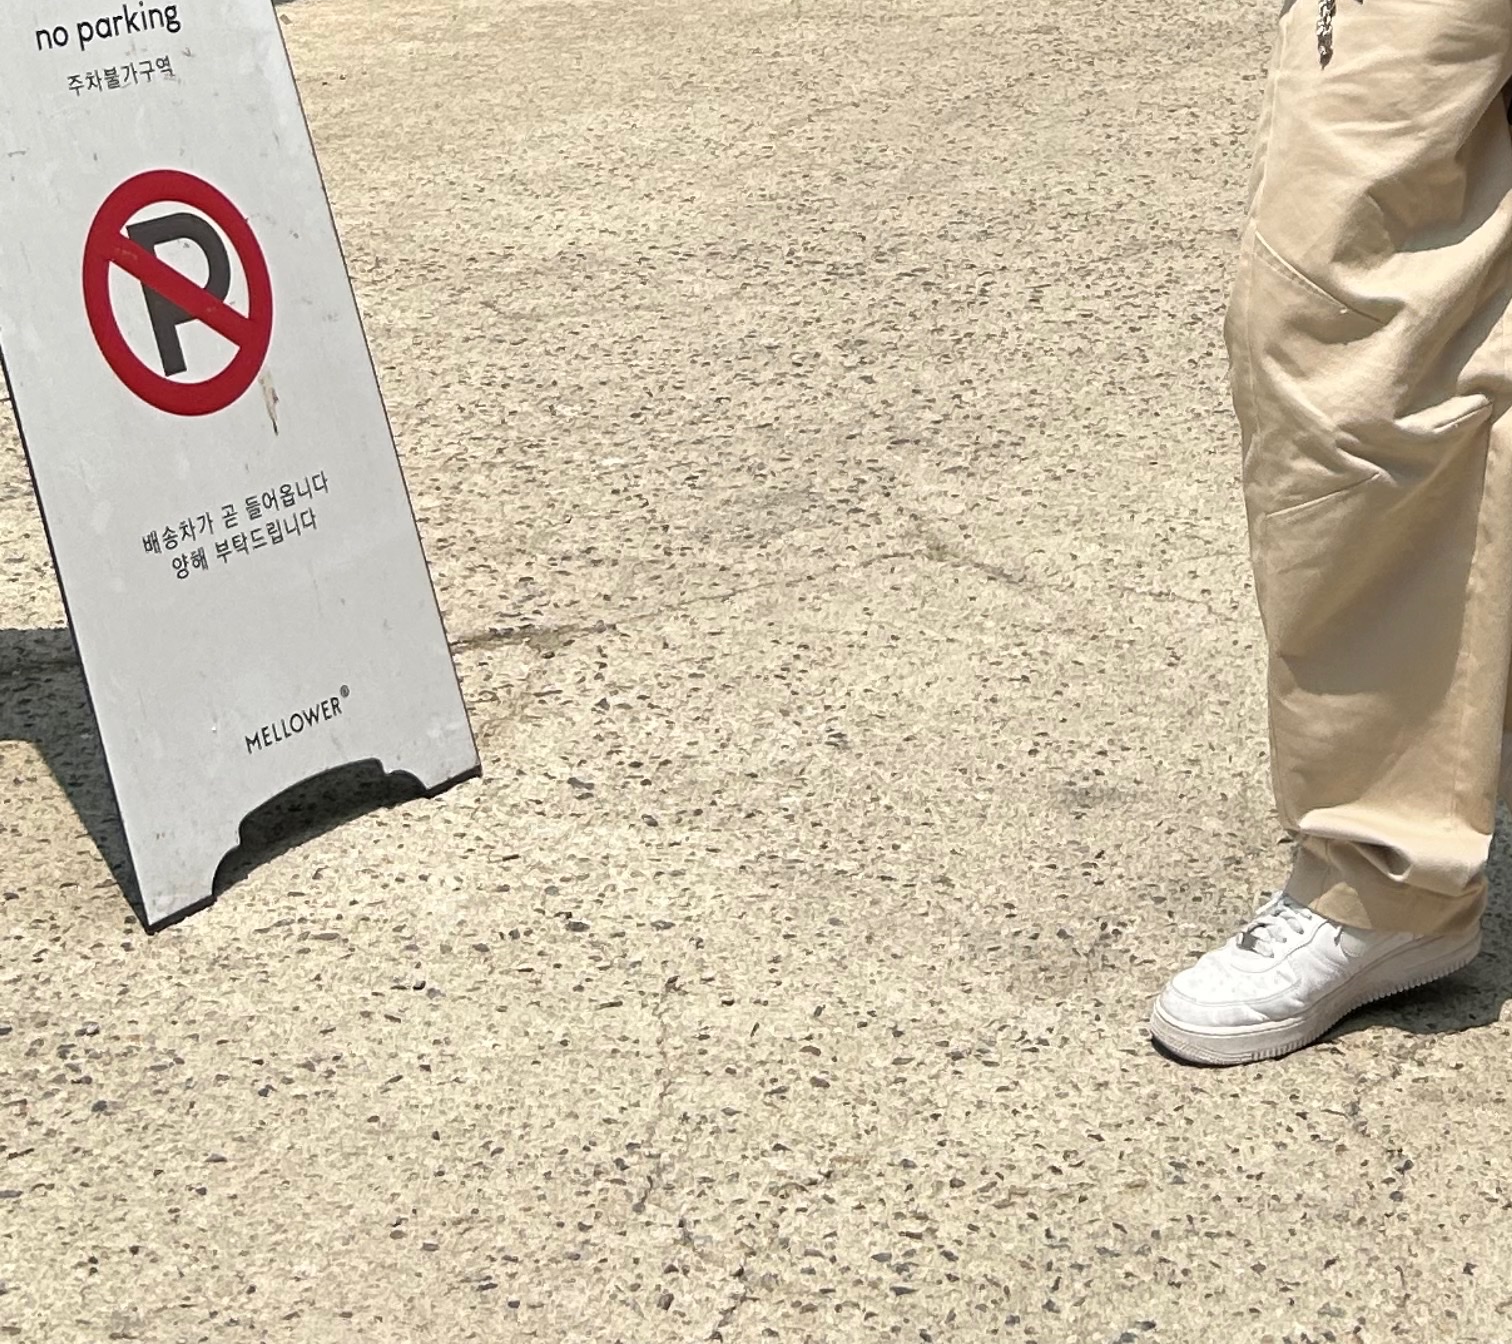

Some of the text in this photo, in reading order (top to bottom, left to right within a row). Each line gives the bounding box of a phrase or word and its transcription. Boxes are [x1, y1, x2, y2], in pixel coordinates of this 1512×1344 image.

[35, 0, 182, 52] no parking
[67, 55, 175, 97] 주차불가구역
[141, 470, 329, 554] 배송차가 곧 들어옵니다
[171, 507, 318, 580] 양해 부탁드립니다
